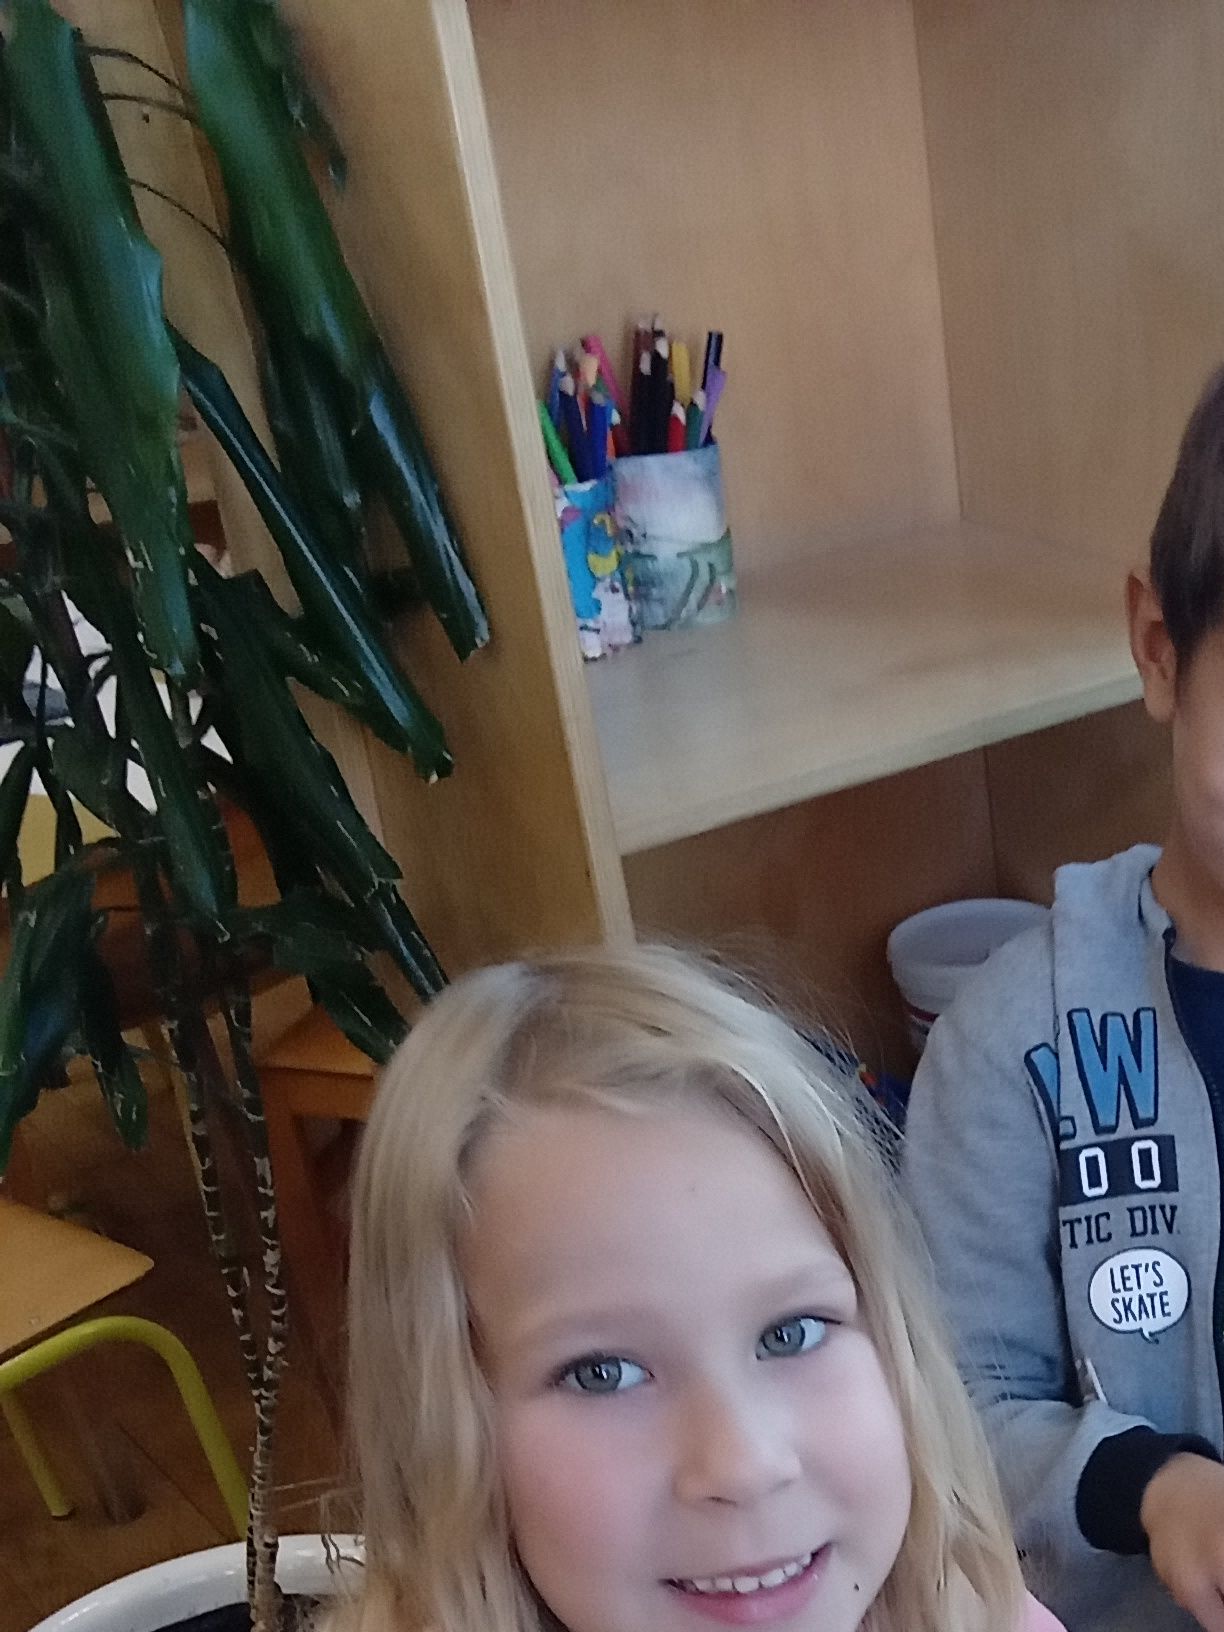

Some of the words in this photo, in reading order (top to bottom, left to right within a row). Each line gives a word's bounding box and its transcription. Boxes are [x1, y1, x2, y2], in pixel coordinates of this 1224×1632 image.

[1062, 1212, 1112, 1249] TIC
[1109, 1260, 1164, 1294] LET'S
[1110, 1290, 1172, 1324] SKATE
